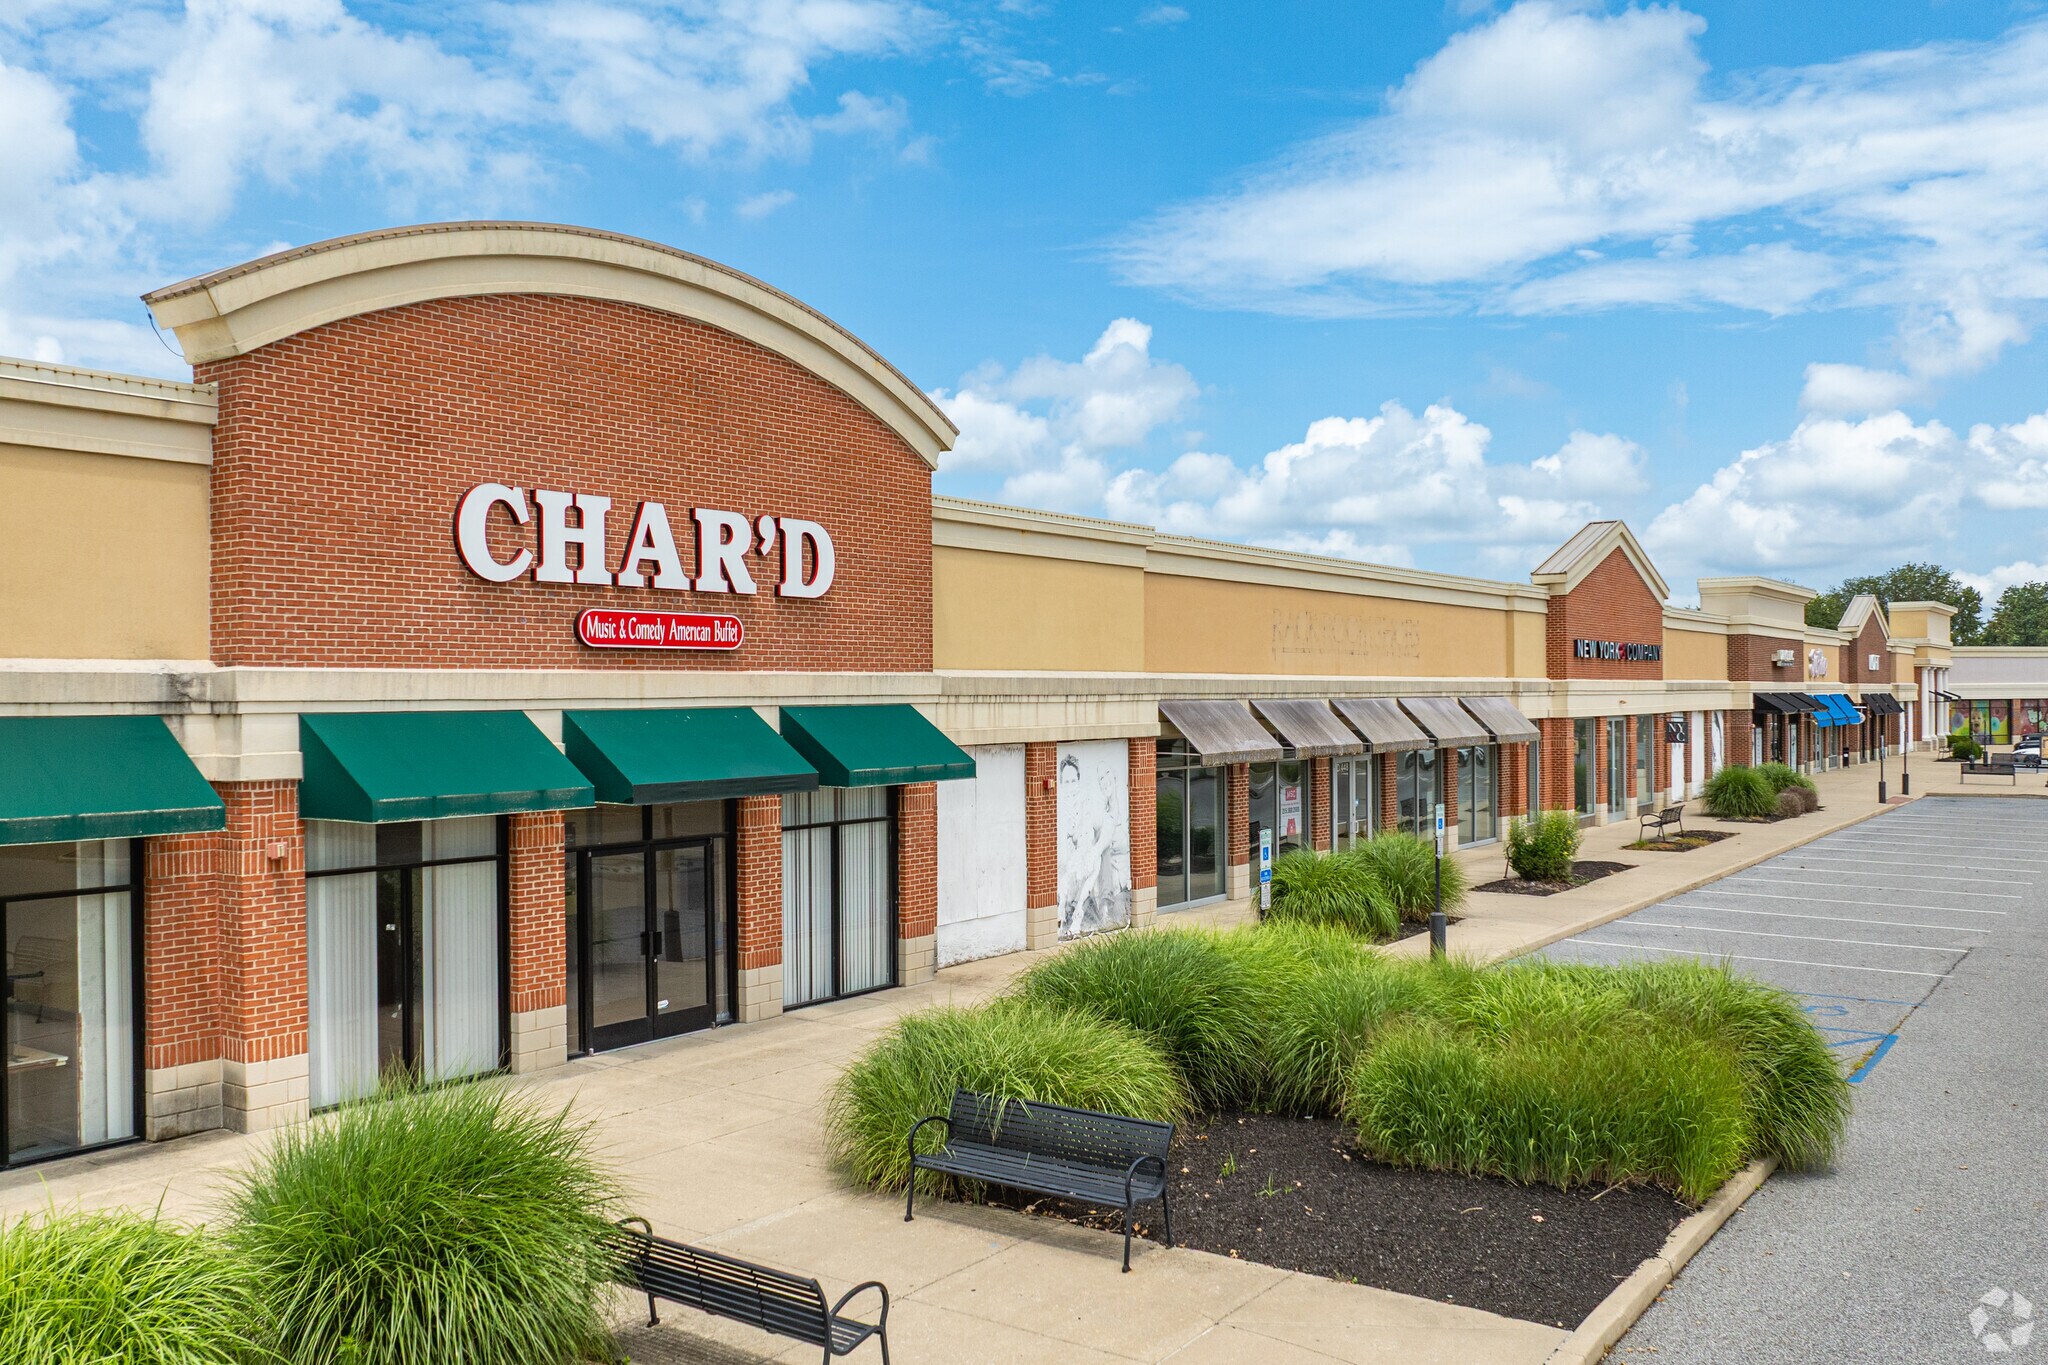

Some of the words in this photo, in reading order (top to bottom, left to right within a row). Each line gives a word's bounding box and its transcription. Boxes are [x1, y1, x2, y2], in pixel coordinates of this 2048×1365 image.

[453, 482, 836, 599] CHAR'D
[586, 615, 616, 639] Music
[619, 618, 627, 640] &
[628, 616, 665, 645] Comedy
[669, 618, 711, 642] American
[714, 620, 738, 643] Buffet
[1576, 639, 1597, 658] NEW
[1599, 641, 1620, 660] YORK
[1626, 643, 1662, 661] COMPANY
